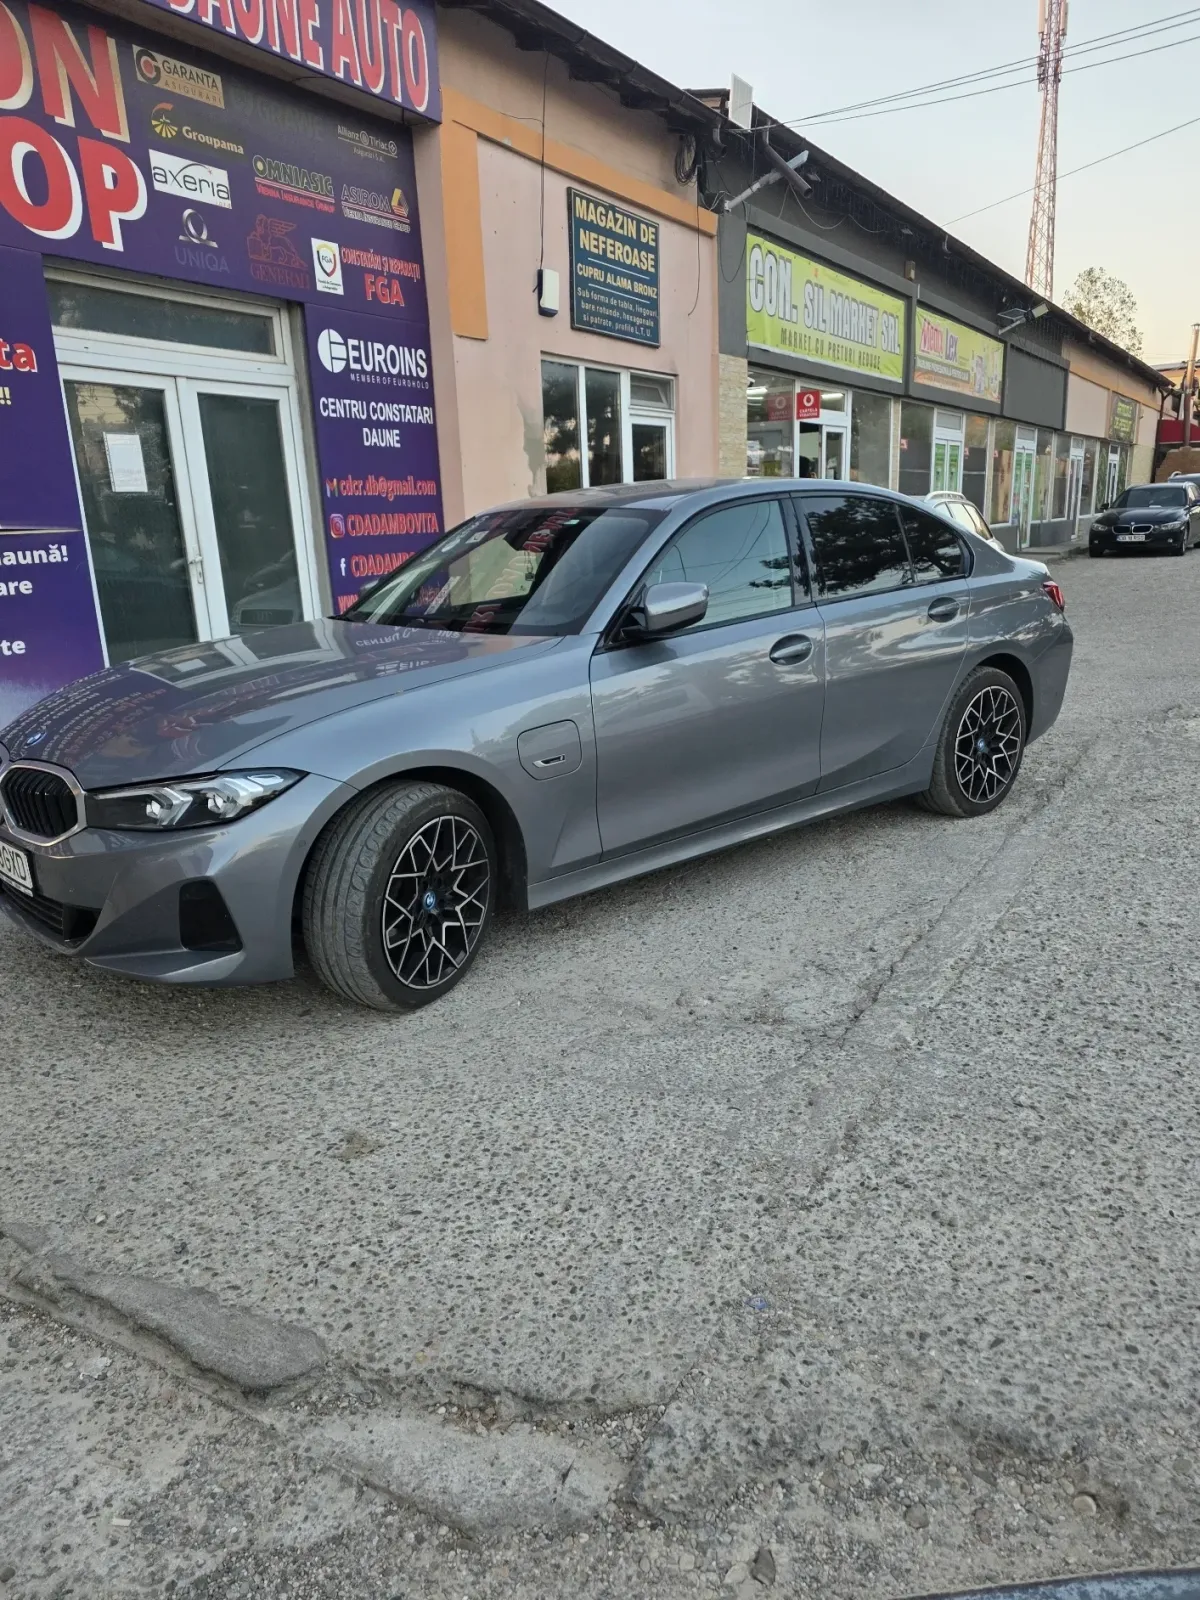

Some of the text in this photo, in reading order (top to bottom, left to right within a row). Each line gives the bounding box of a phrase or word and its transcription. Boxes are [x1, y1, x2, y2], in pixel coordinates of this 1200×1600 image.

[331, 0, 429, 112] AUTO
[162, 60, 219, 92] GARANTA
[182, 126, 245, 155] Groupama
[152, 163, 230, 201] axeria
[252, 155, 335, 197] OMNIASIG
[341, 183, 392, 213] ASIROM
[575, 196, 656, 247] MAGAZIN DE
[174, 245, 231, 274] UNIQA
[579, 227, 656, 273] NEFEROASE
[250, 263, 311, 291] GENERALI
[364, 273, 405, 307] FGA
[577, 262, 658, 299] CUPRU ALAMA BRONZ
[577, 286, 590, 299] Sub
[590, 290, 609, 304] forma
[609, 295, 619, 307] de
[581, 300, 596, 312] bare
[749, 243, 798, 324] CON.
[829, 288, 880, 349] MARKET
[880, 309, 901, 355] SRL
[780, 327, 812, 351] MARKET
[347, 338, 428, 379] EUROINS
[350, 372, 430, 390] MEMBER OF EUROHOLD
[320, 396, 434, 425] CENTRU CONSTATARI
[362, 427, 401, 448] DAUNE
[347, 512, 439, 537] CDADAMBOVITA
[0, 543, 69, 566] aună!
